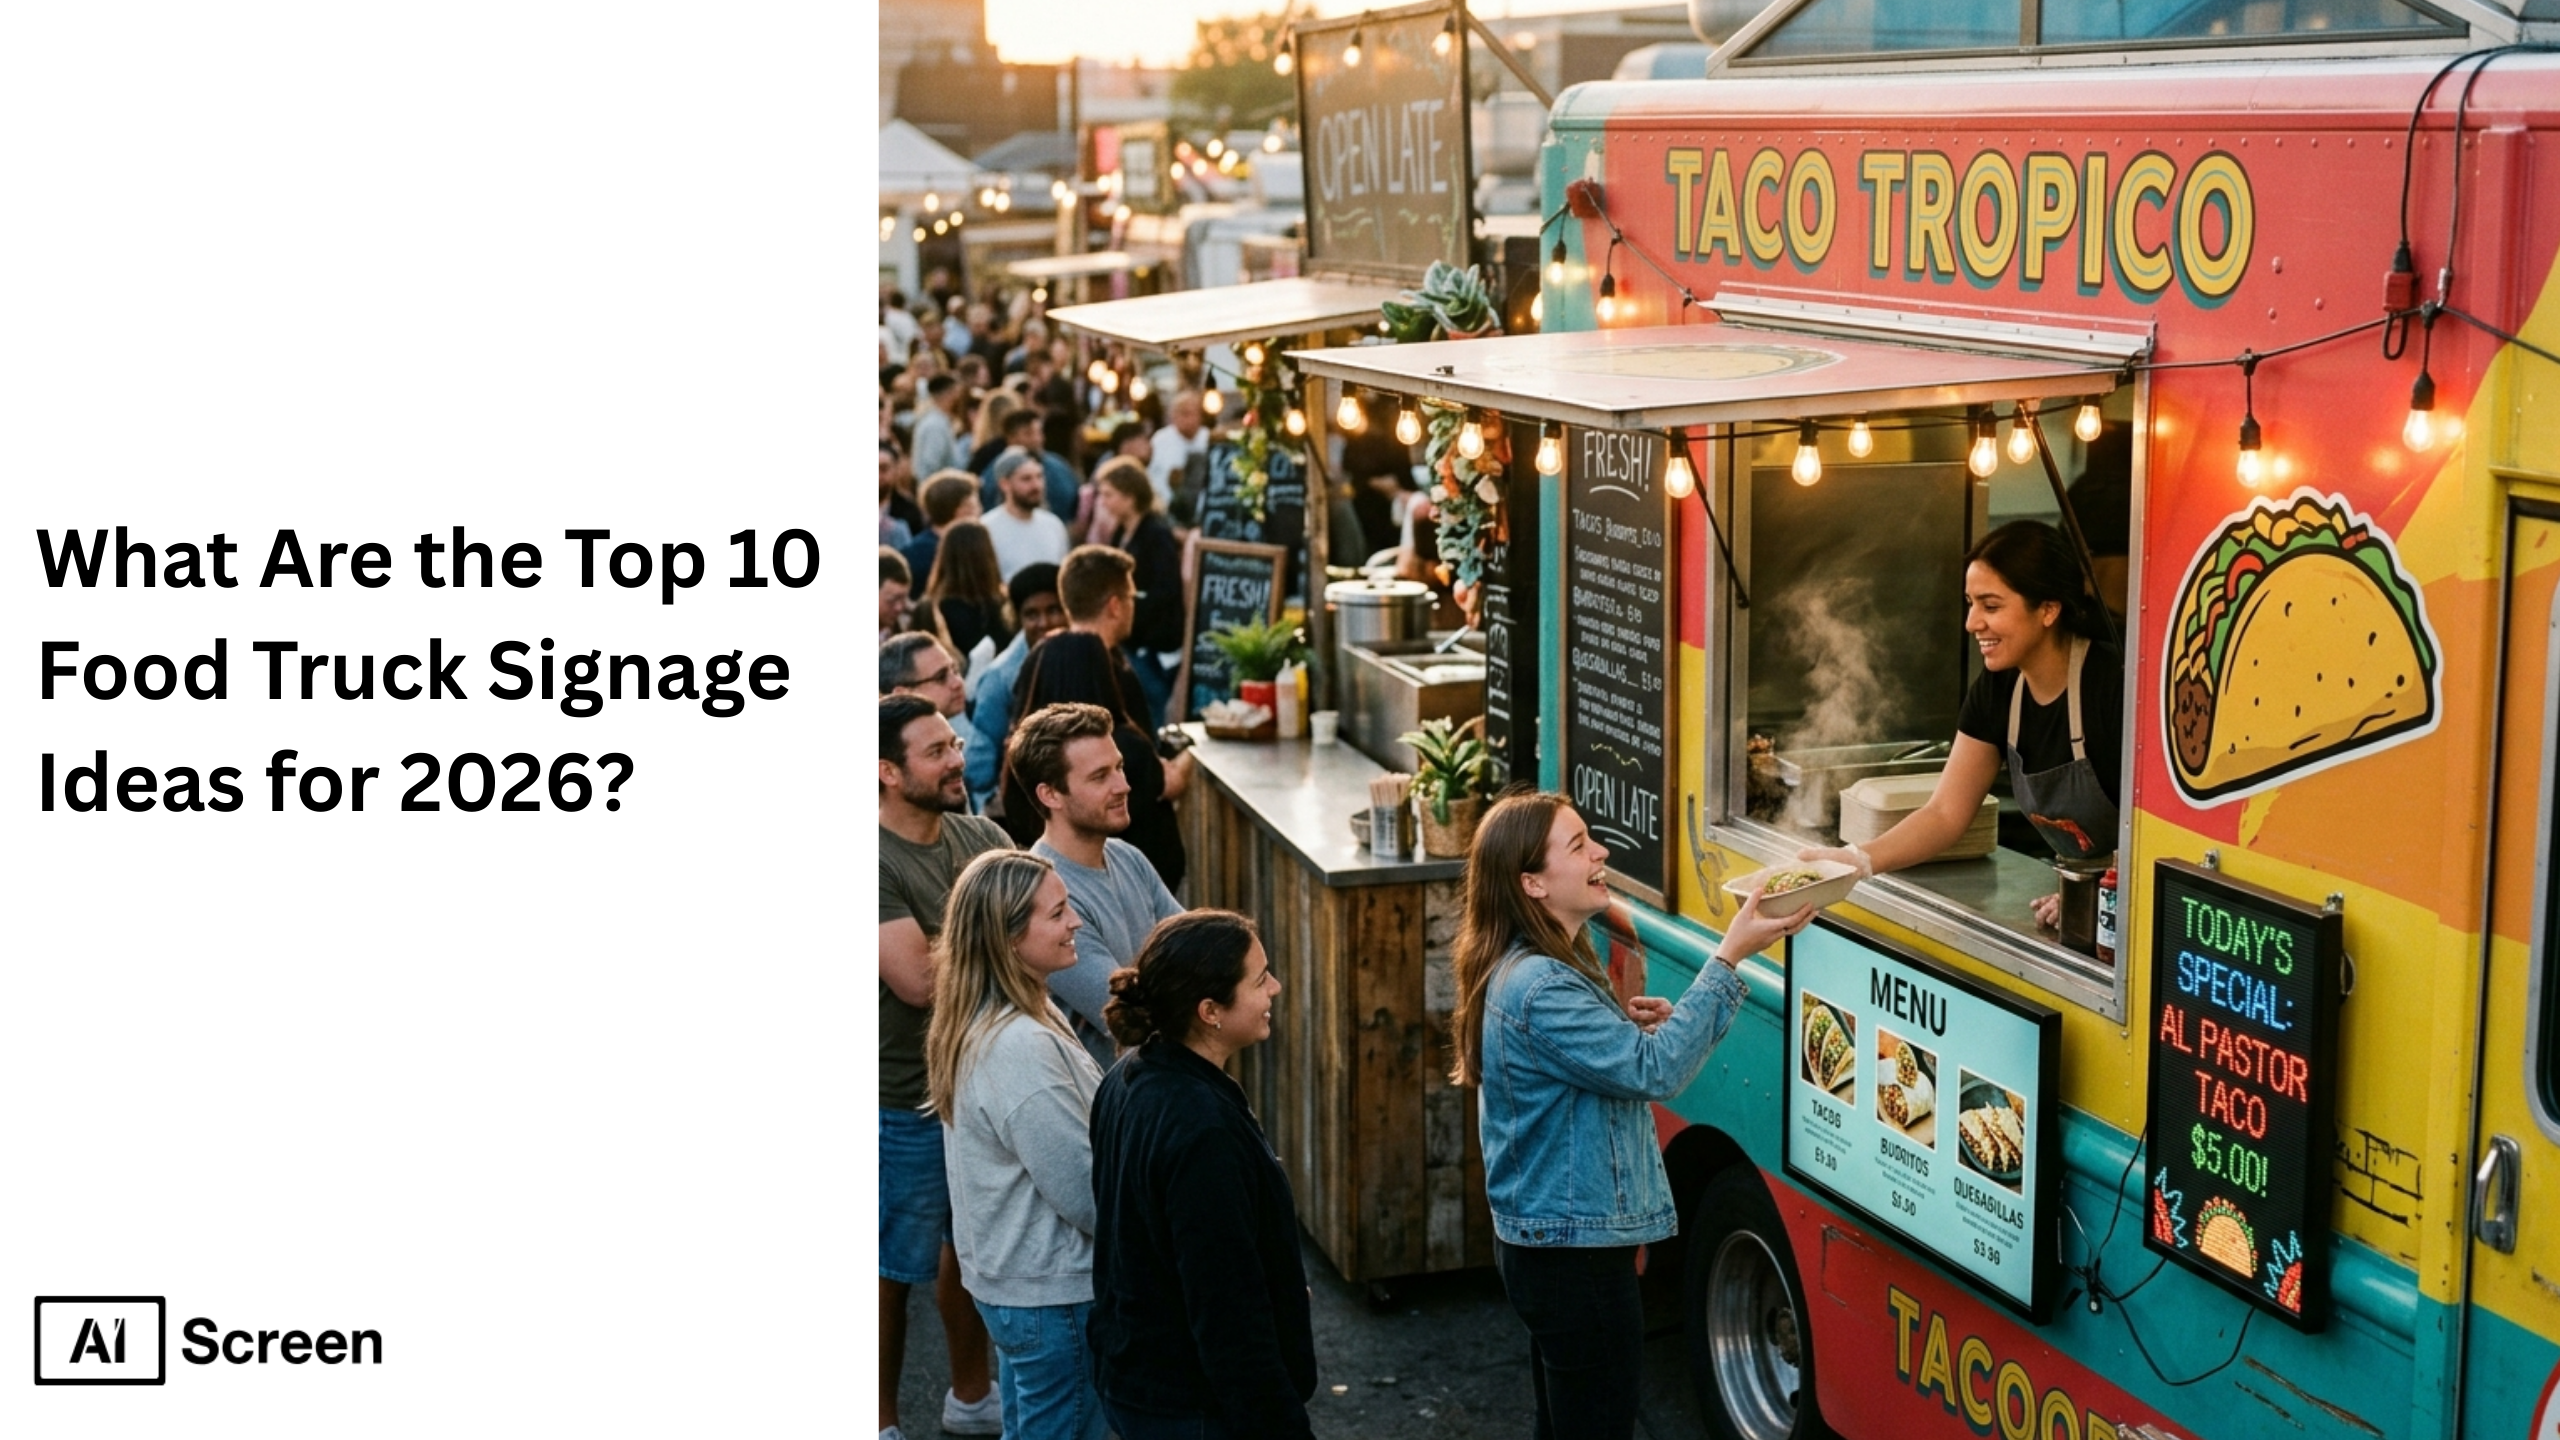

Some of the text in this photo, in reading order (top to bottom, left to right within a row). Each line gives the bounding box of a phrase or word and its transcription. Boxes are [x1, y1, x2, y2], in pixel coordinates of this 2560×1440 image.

[1316, 98, 1448, 204] OPEN LATE
[1665, 147, 2255, 309] TACO TROPICO
[1583, 430, 1652, 493] FRESH!
[1574, 763, 1661, 842] OPEN LATE
[2181, 896, 2294, 975] TODAY'S
[1870, 966, 1947, 1037] MENU
[2177, 950, 2294, 1031] SPECIAL:
[2160, 1003, 2309, 1103] AL PASTOR
[2194, 1069, 2268, 1140] TACO
[2190, 1122, 2269, 1198] $5.00!
